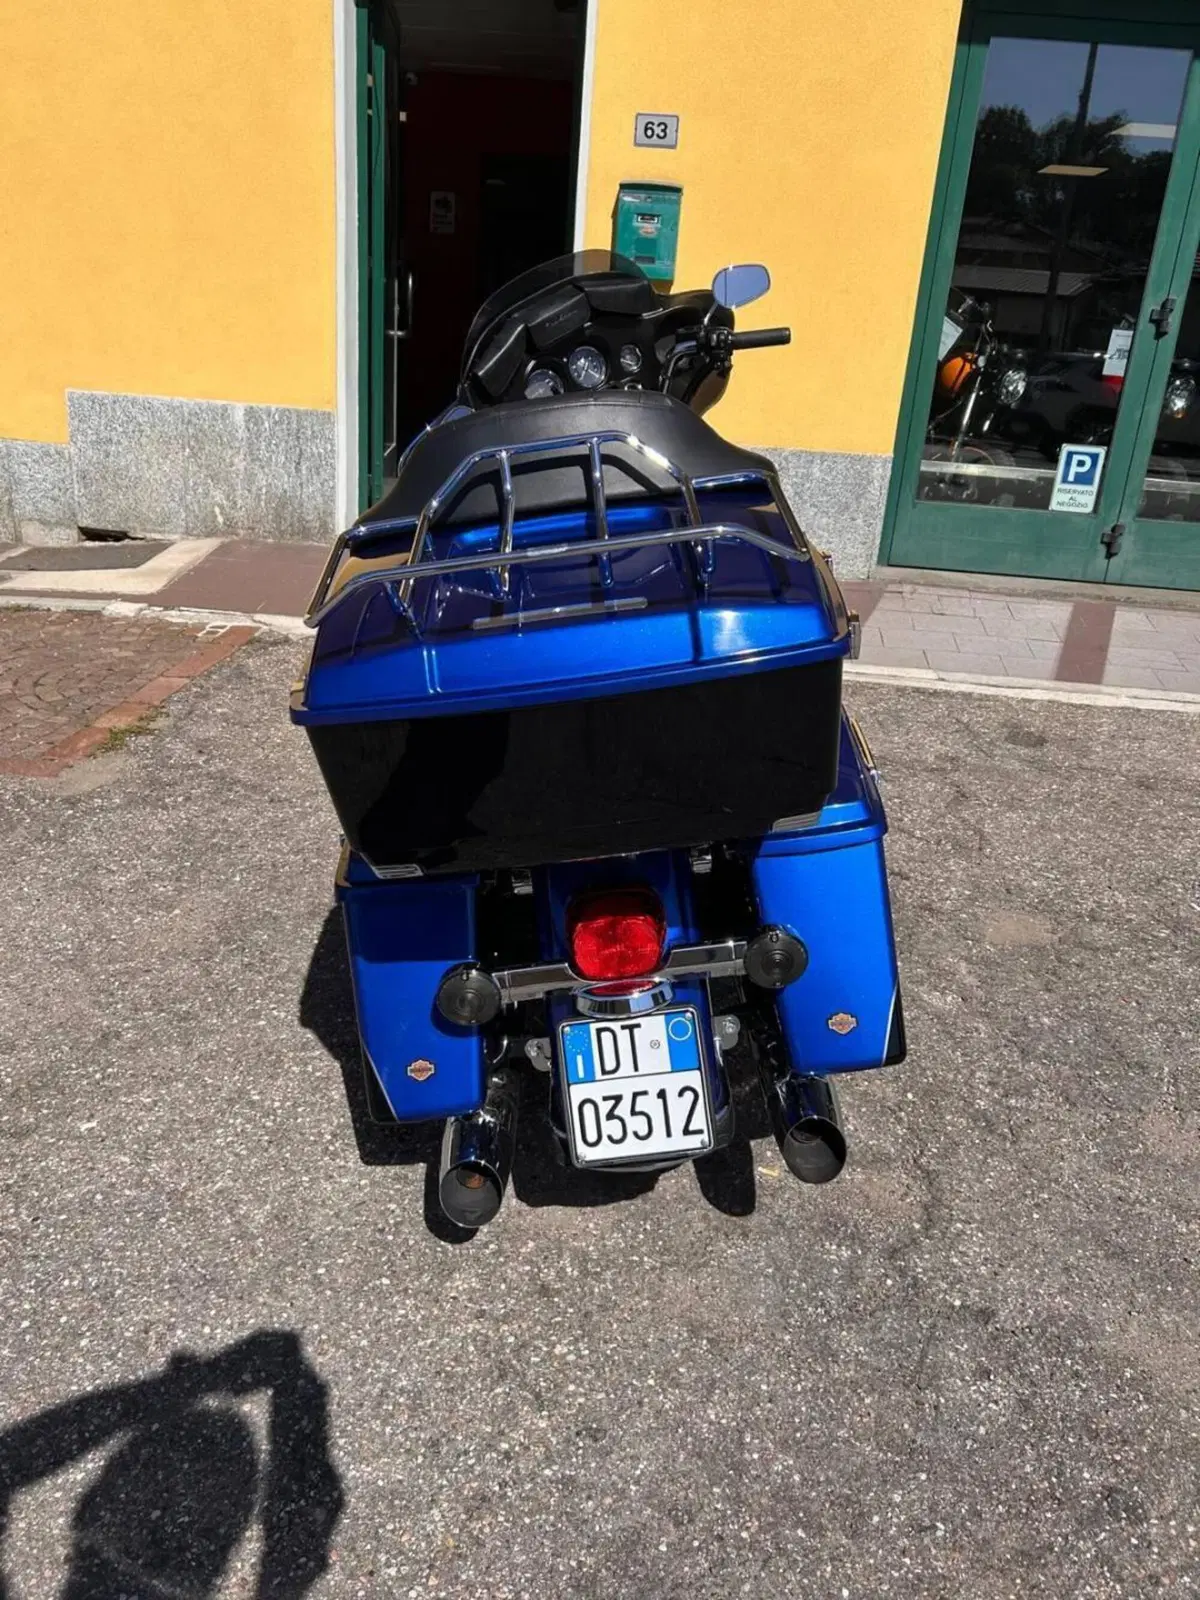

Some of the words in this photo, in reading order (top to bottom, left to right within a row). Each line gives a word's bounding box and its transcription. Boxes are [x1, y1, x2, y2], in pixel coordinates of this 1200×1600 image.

[643, 121, 668, 140] 63
[1067, 453, 1092, 482] P
[1056, 500, 1088, 509] NEGOZIO
[1057, 488, 1094, 497] RISERVATO
[595, 1023, 642, 1076] DT
[576, 1054, 585, 1079] I
[577, 1085, 705, 1148] 03512
